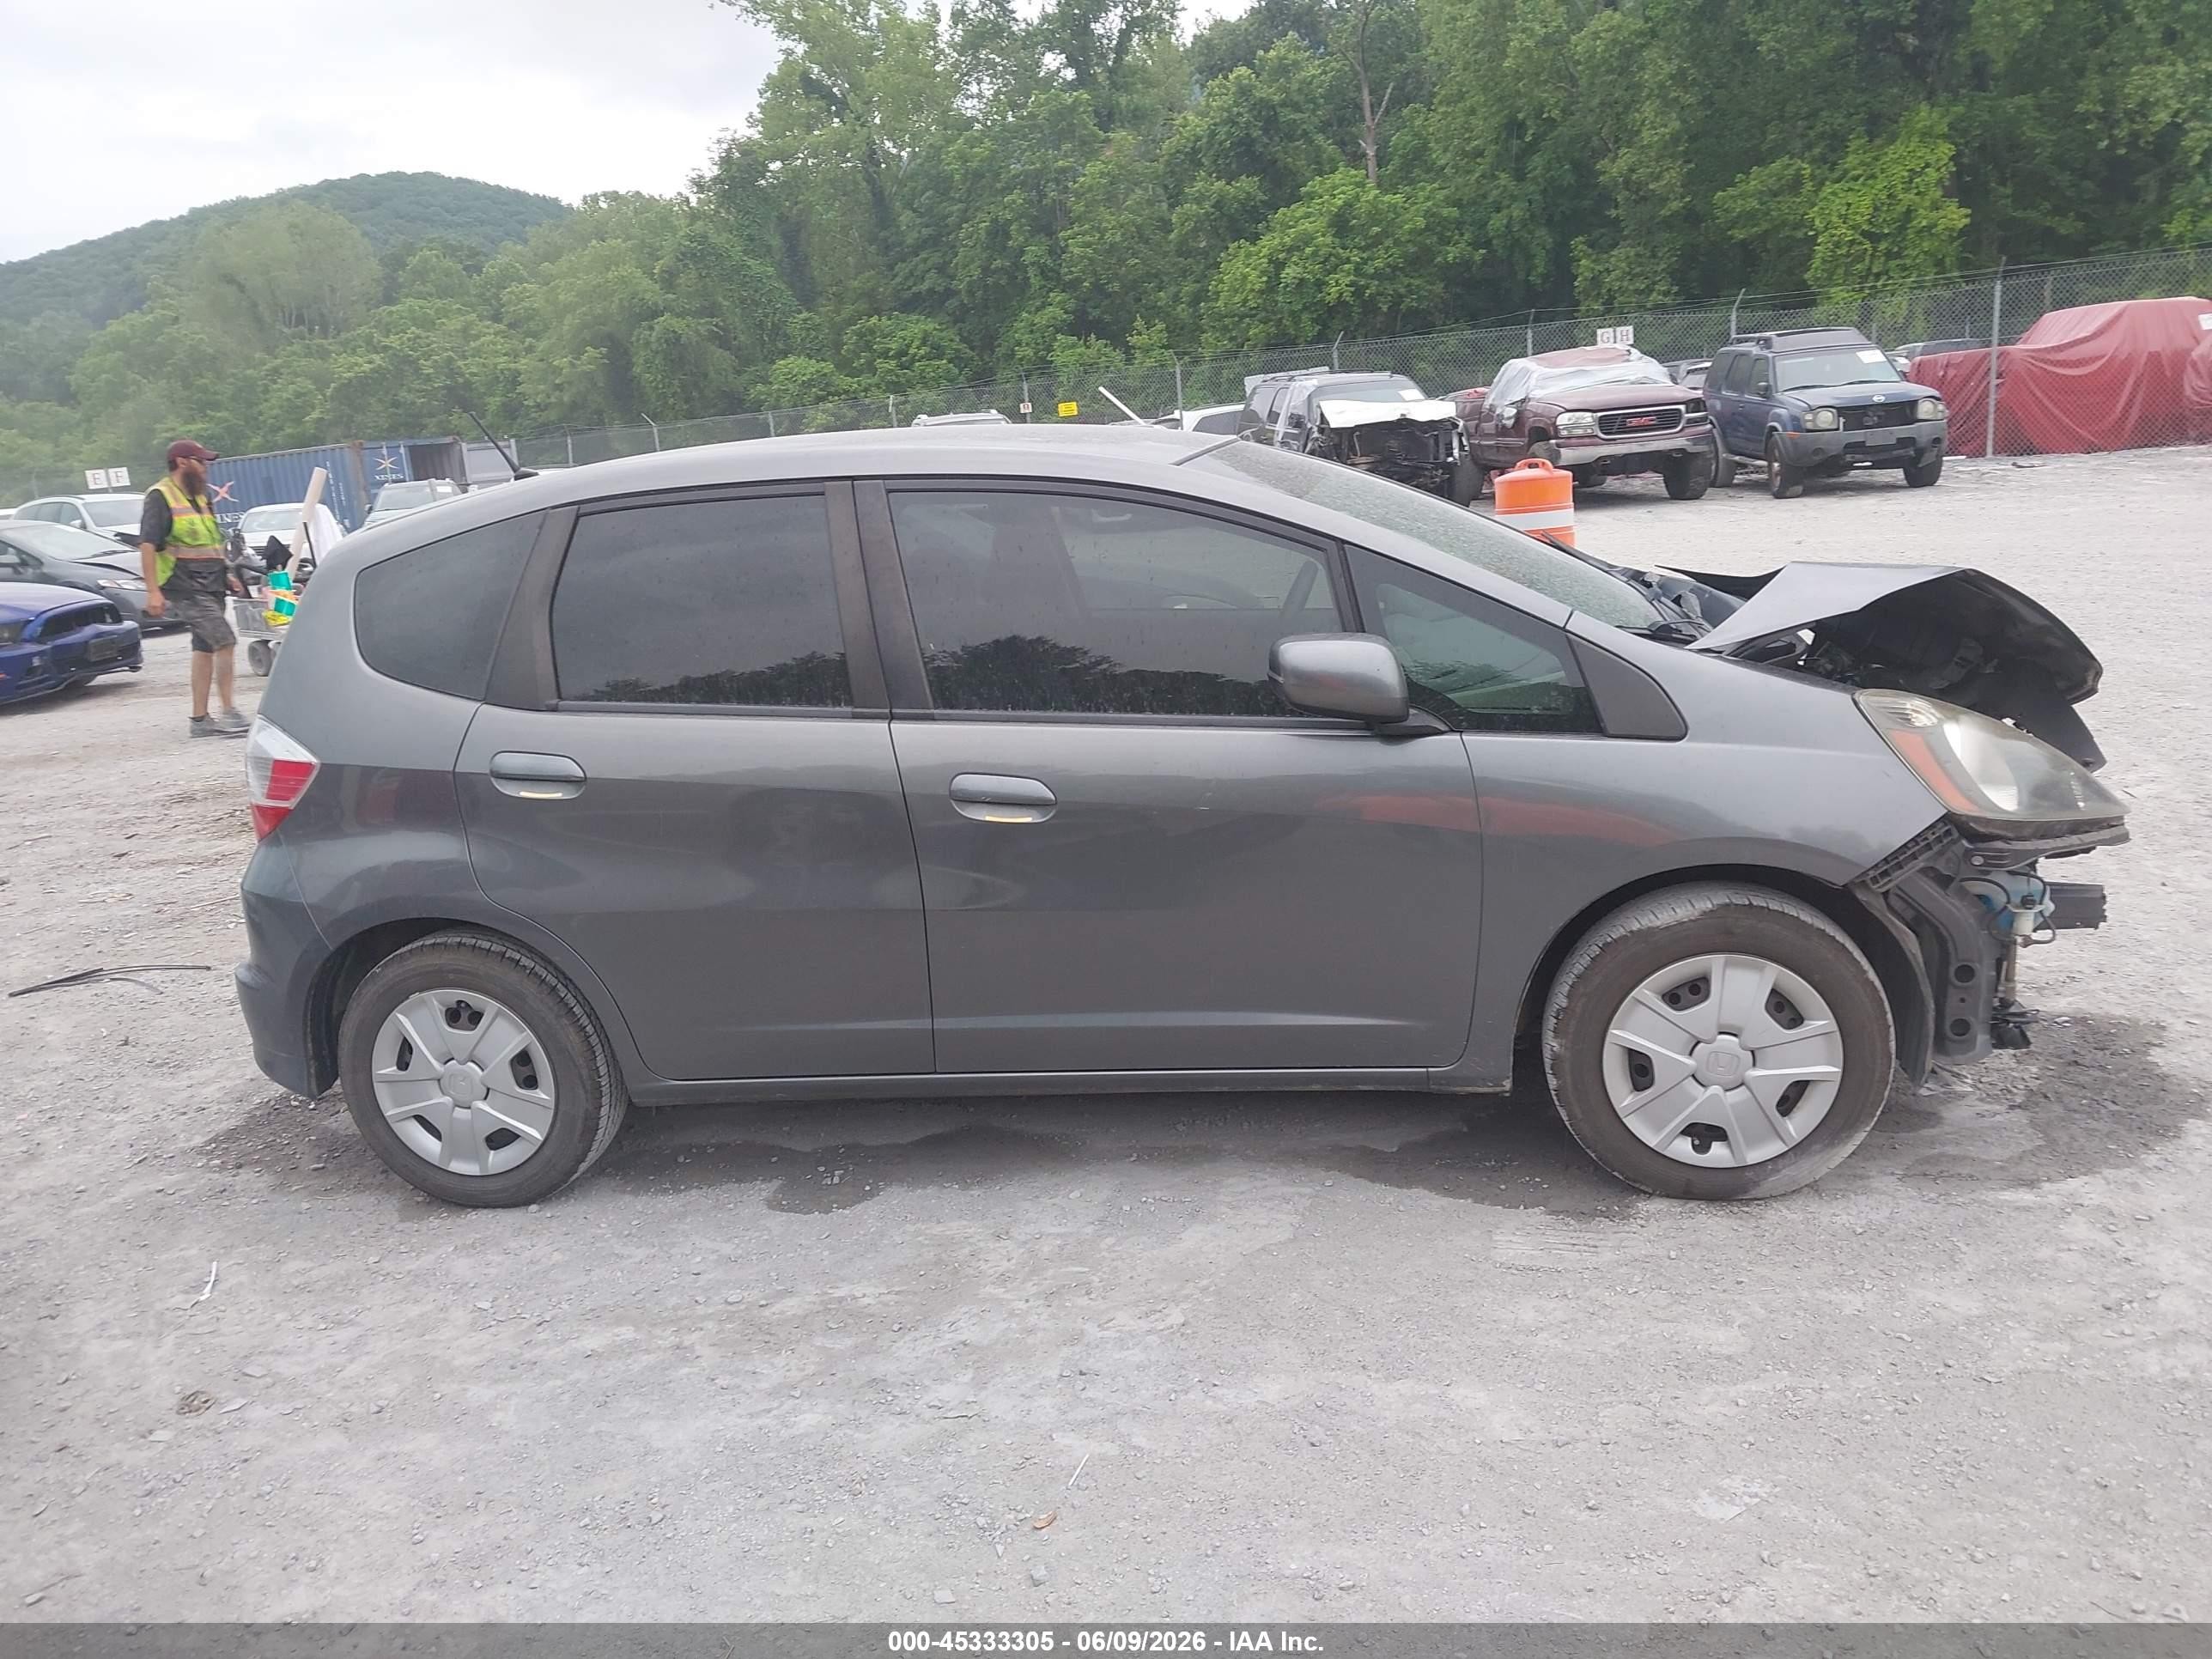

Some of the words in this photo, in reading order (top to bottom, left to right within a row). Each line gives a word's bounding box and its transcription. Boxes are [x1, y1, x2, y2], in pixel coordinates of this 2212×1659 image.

[1601, 331, 1610, 343] G
[1620, 329, 1630, 343] H
[92, 472, 103, 485] E
